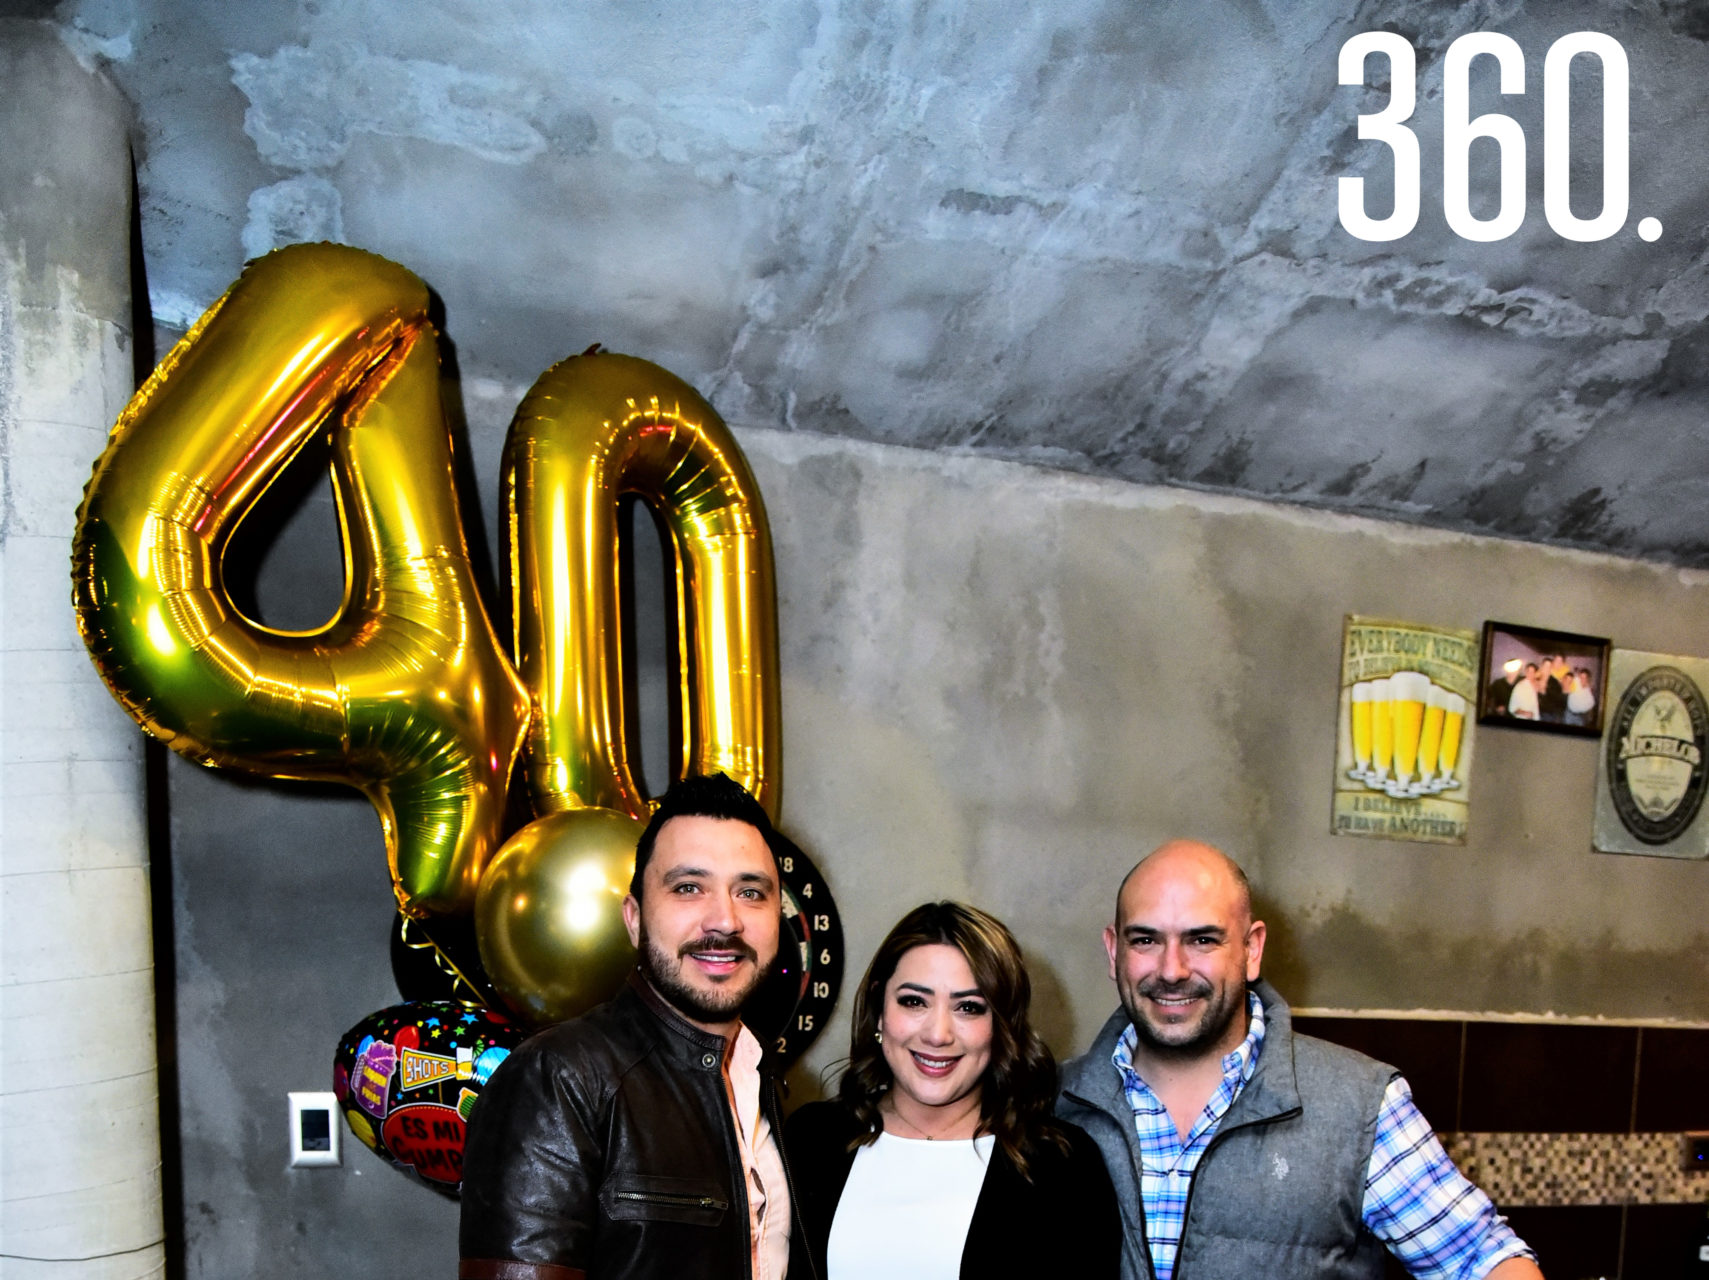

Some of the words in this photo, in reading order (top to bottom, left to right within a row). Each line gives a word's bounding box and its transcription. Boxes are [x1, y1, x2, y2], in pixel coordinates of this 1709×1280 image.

[802, 883, 813, 899] 4
[814, 914, 830, 931] 13
[820, 949, 831, 965] 6
[813, 982, 830, 998] 10
[798, 1015, 814, 1032] 15
[405, 1056, 449, 1083] SHOTS
[401, 1116, 429, 1140] ES
[432, 1121, 461, 1143] MI
